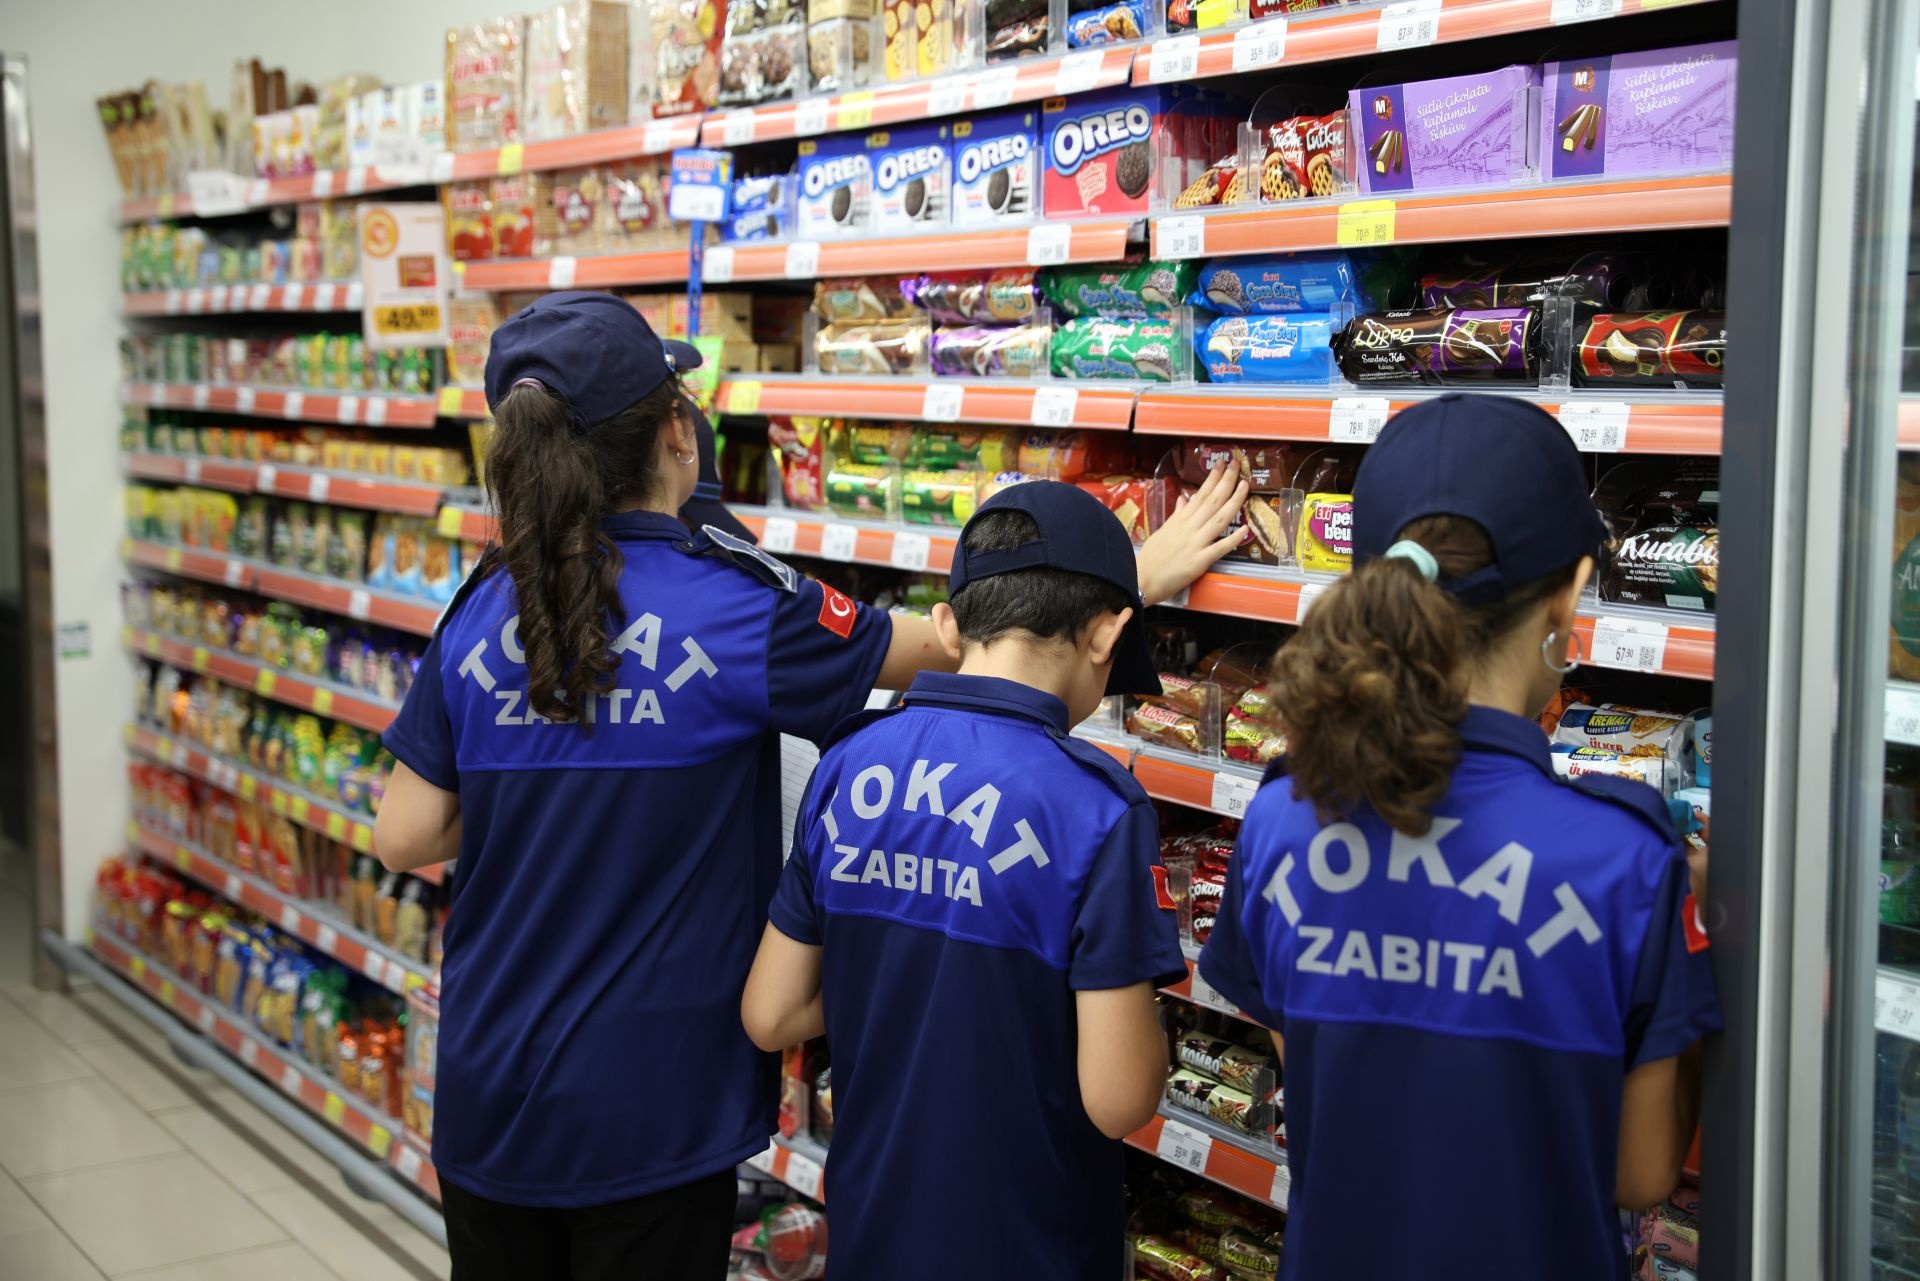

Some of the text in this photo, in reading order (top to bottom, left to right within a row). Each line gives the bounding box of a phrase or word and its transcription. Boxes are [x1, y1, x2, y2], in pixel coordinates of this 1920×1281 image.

[1575, 71, 1588, 86] M
[1622, 50, 1718, 91] Sütlü Çikolata
[1629, 73, 1698, 103] Kaplamalı
[1375, 99, 1387, 114] M
[1416, 83, 1492, 119] Sütlü Çikolata
[1423, 101, 1478, 130] Kaplamalı
[1635, 92, 1682, 116] Bisküvi
[1053, 104, 1150, 167] OREO
[1430, 120, 1467, 142] Bisküvi
[804, 154, 872, 198] OREO
[876, 145, 945, 191] OREO
[959, 133, 1029, 184] OREO
[458, 612, 718, 692] TOAT
[495, 689, 665, 726] ZAITA
[1590, 737, 1624, 753] ÜLKER
[820, 759, 1050, 877] TOKAT
[830, 843, 983, 908] ZABITA
[1261, 816, 1604, 960] TOKAT
[1296, 925, 1524, 999] ZABITA
[1181, 1045, 1221, 1075] KOMBO
[1169, 1087, 1210, 1116] KOMBO
